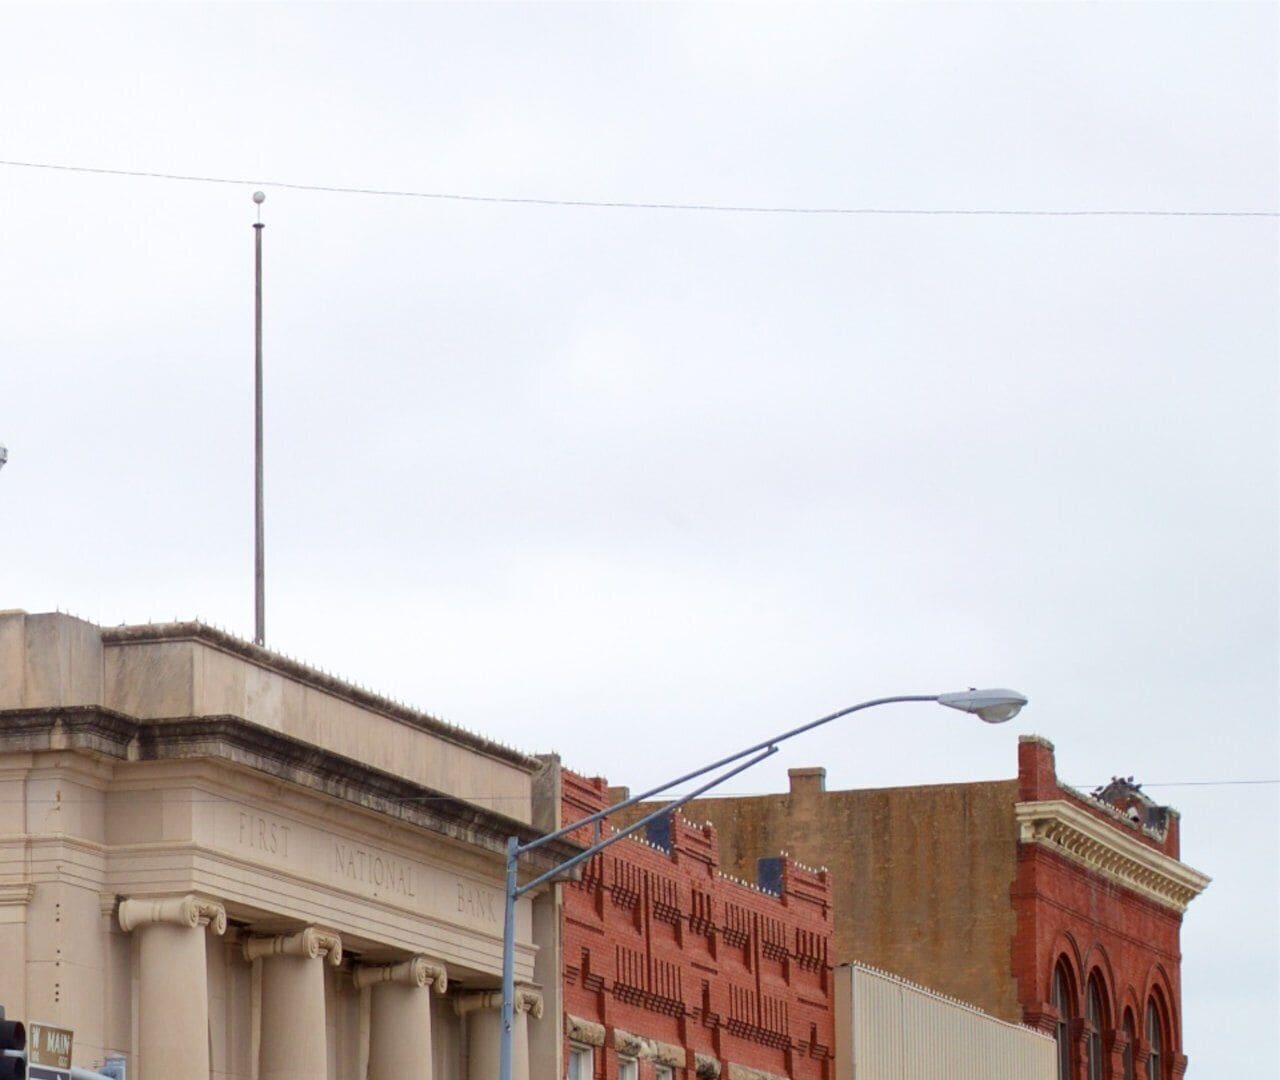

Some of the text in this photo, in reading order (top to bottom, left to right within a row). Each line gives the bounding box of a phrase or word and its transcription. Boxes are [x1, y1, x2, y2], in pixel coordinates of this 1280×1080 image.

[239, 812, 498, 922] FIRST NATIONAL BANK
[46, 1031, 71, 1056] MAIN
